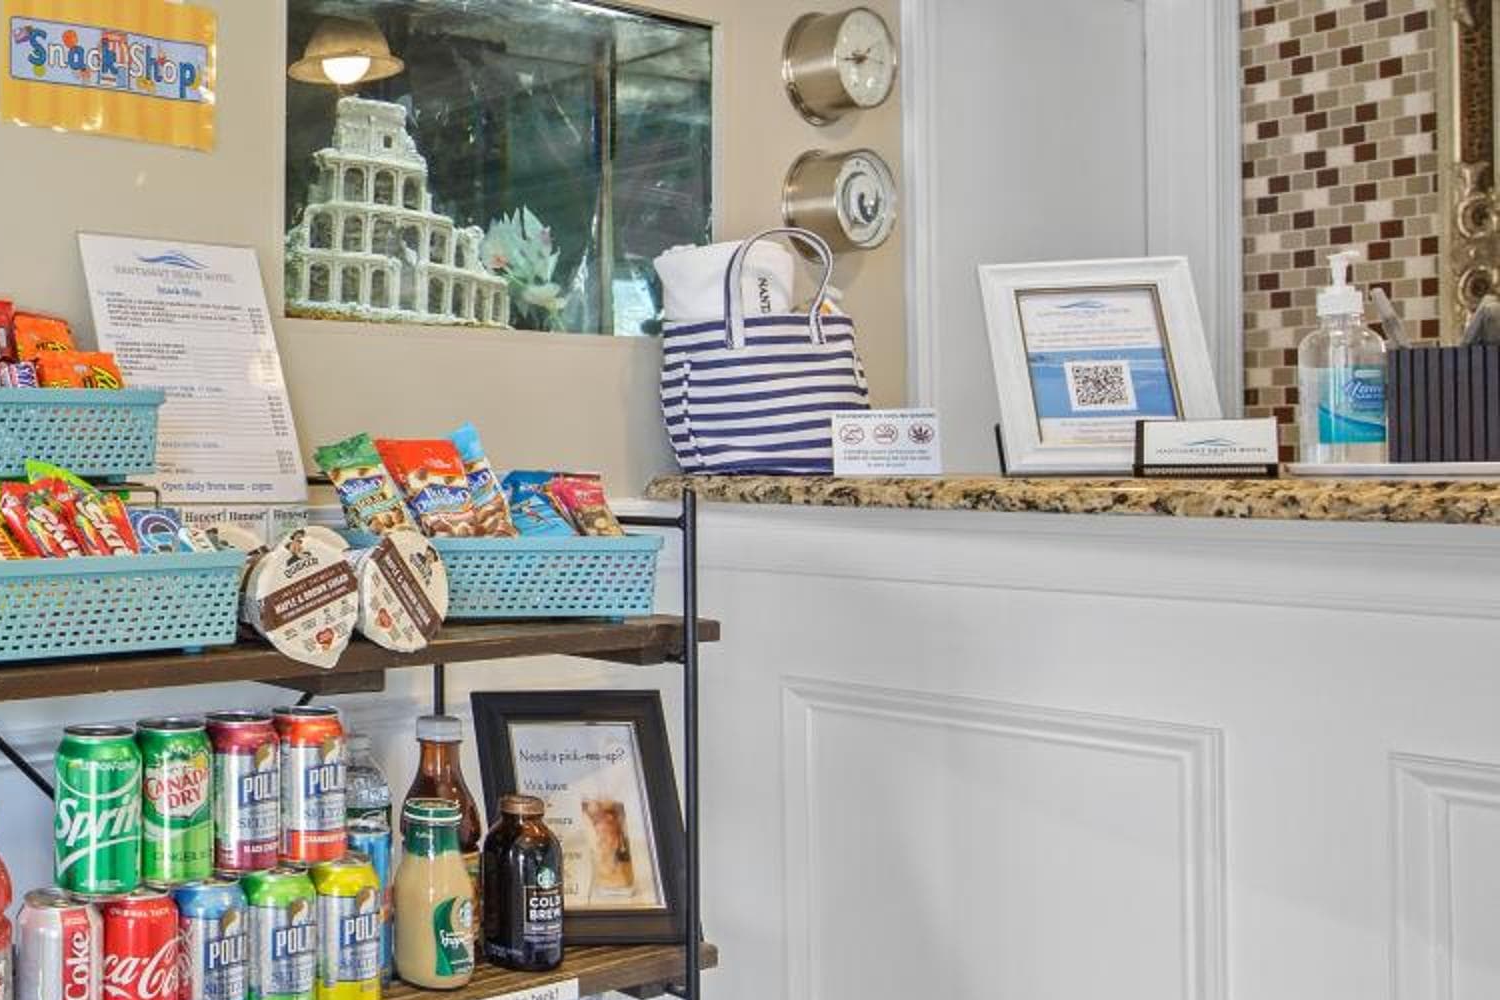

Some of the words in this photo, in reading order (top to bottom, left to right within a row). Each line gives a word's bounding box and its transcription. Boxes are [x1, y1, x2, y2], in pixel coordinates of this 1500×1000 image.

[28, 27, 122, 76] Snack
[129, 42, 197, 99] Shop
[519, 748, 548, 762] Need
[167, 788, 201, 809] DRY
